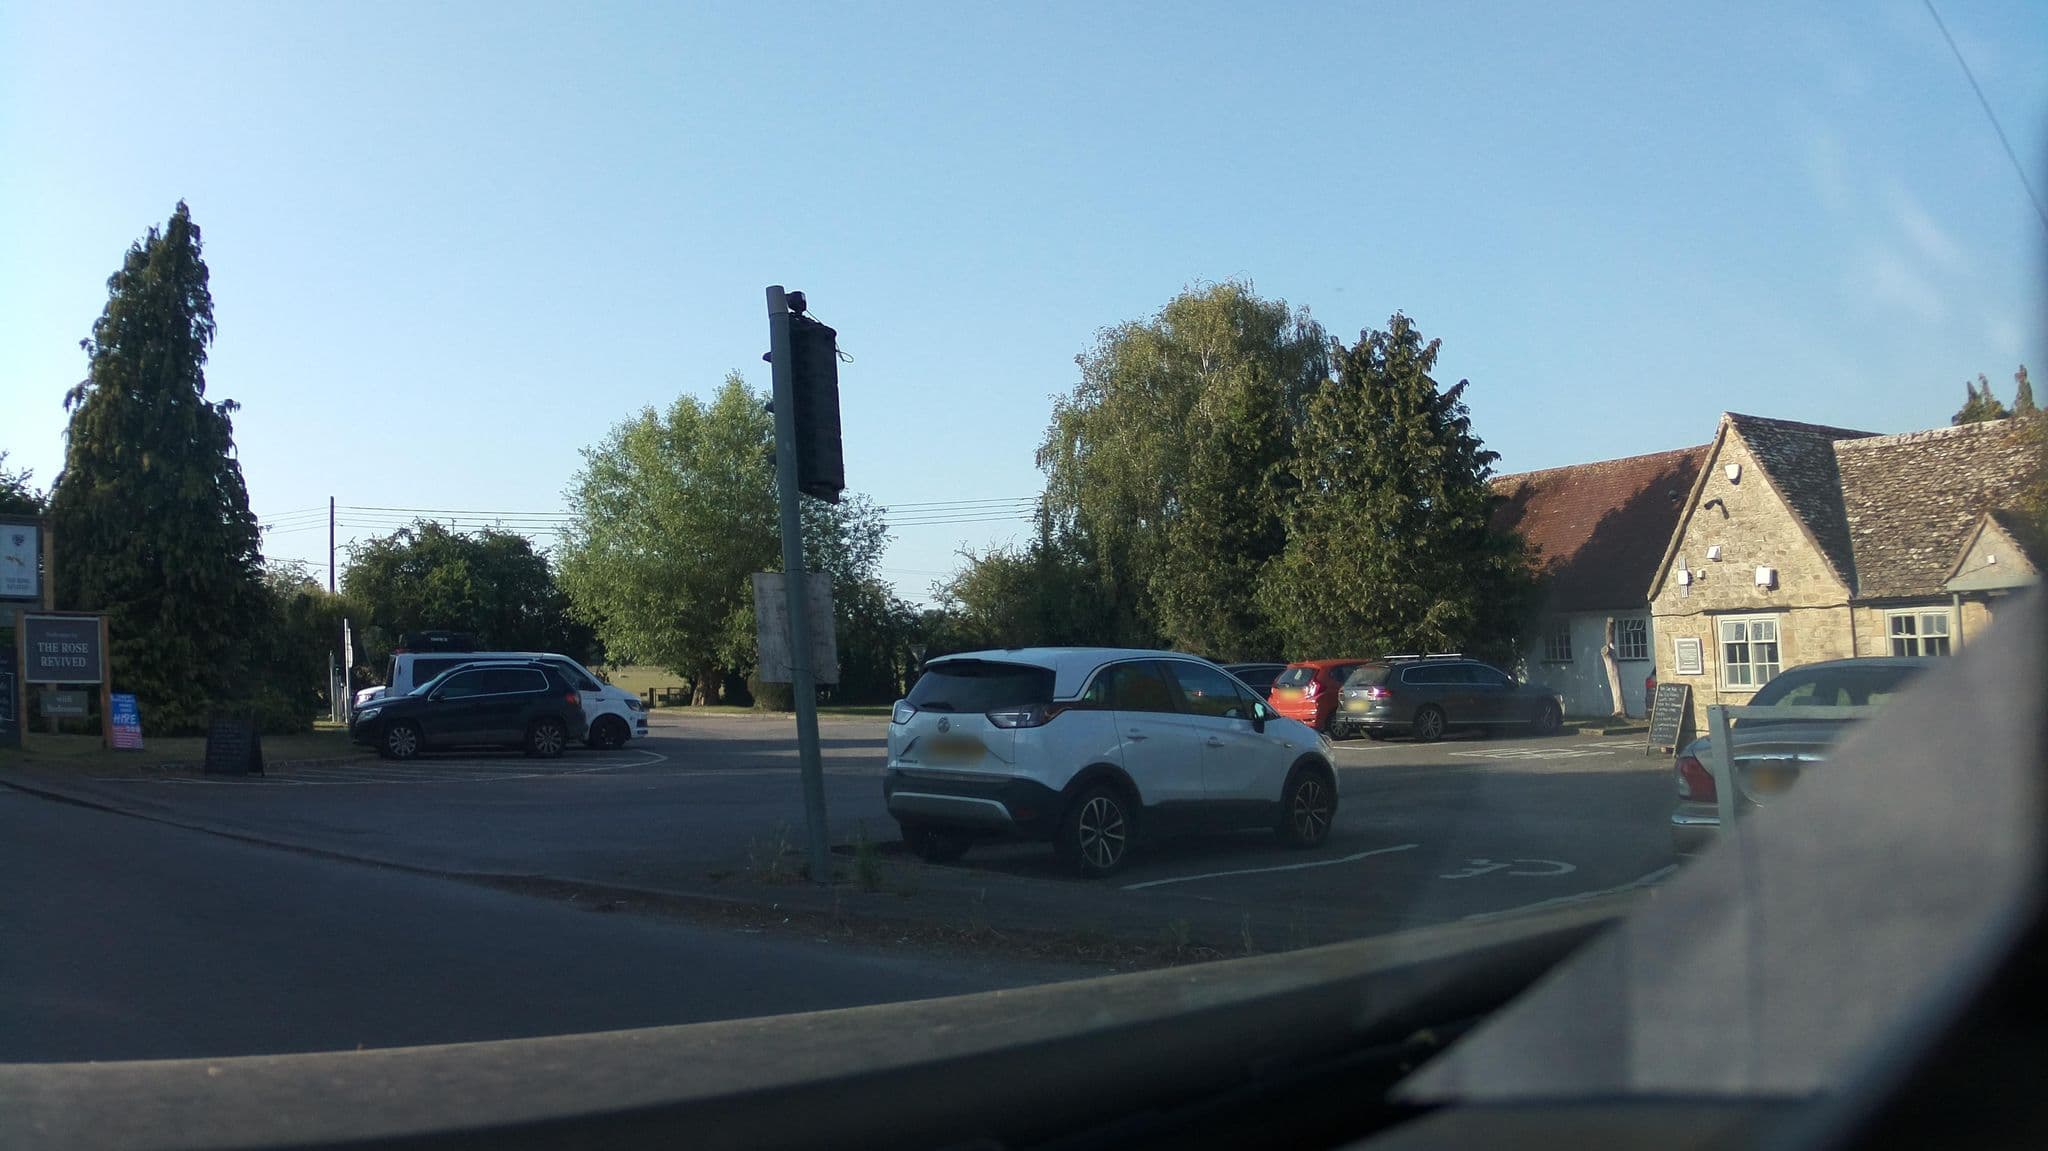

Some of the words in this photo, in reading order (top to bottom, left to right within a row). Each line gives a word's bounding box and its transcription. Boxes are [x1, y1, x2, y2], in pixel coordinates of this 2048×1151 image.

[37, 642, 59, 653] THE
[61, 642, 89, 654] ROSE
[40, 656, 86, 668] REVIVED
[113, 713, 137, 725] HIRE
